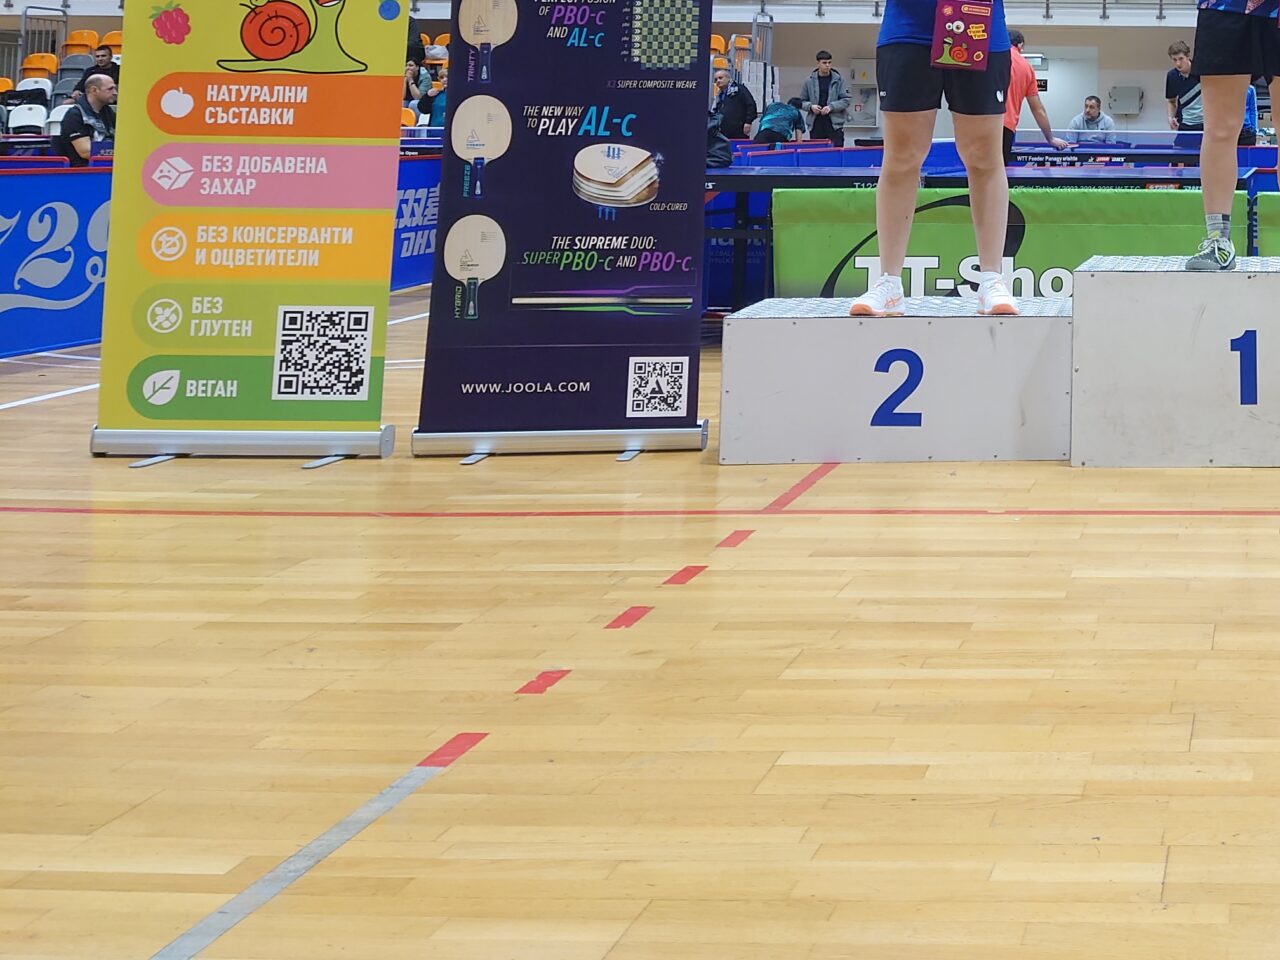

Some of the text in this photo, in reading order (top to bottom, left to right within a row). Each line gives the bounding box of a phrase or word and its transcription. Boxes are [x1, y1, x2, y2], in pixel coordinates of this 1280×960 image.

[539, 6, 549, 16] OF
[547, 26, 568, 38] AND
[617, 80, 696, 89] SUPER COMPOSITE WEAVE
[206, 85, 308, 104] НАТУРАЛНИ
[204, 107, 295, 126] СЪСТАВКИ
[523, 106, 584, 117] THE NEW WAY
[527, 118, 537, 128] TO
[538, 118, 578, 136] PLAY
[201, 156, 328, 176] БЕЗ ДОБАВЕНА
[200, 179, 257, 195] ЗАХАР
[649, 203, 688, 211] COLD-CURED
[196, 226, 353, 244] БЕЗ КОНСЕРВАНТИ
[551, 237, 658, 249] THE SUPREME DUO:
[196, 250, 320, 268] И ОЦВЕТИТЕЛИ
[522, 252, 559, 265] SUPER
[617, 256, 637, 268] AND
[192, 297, 223, 313] БЕЗ
[190, 320, 252, 337] ГЛУТЕН
[1230, 329, 1259, 406] 1
[185, 380, 238, 398] ВЕГАН
[461, 382, 591, 393] WWW.JOOLA.COM
[870, 348, 924, 427] 2
